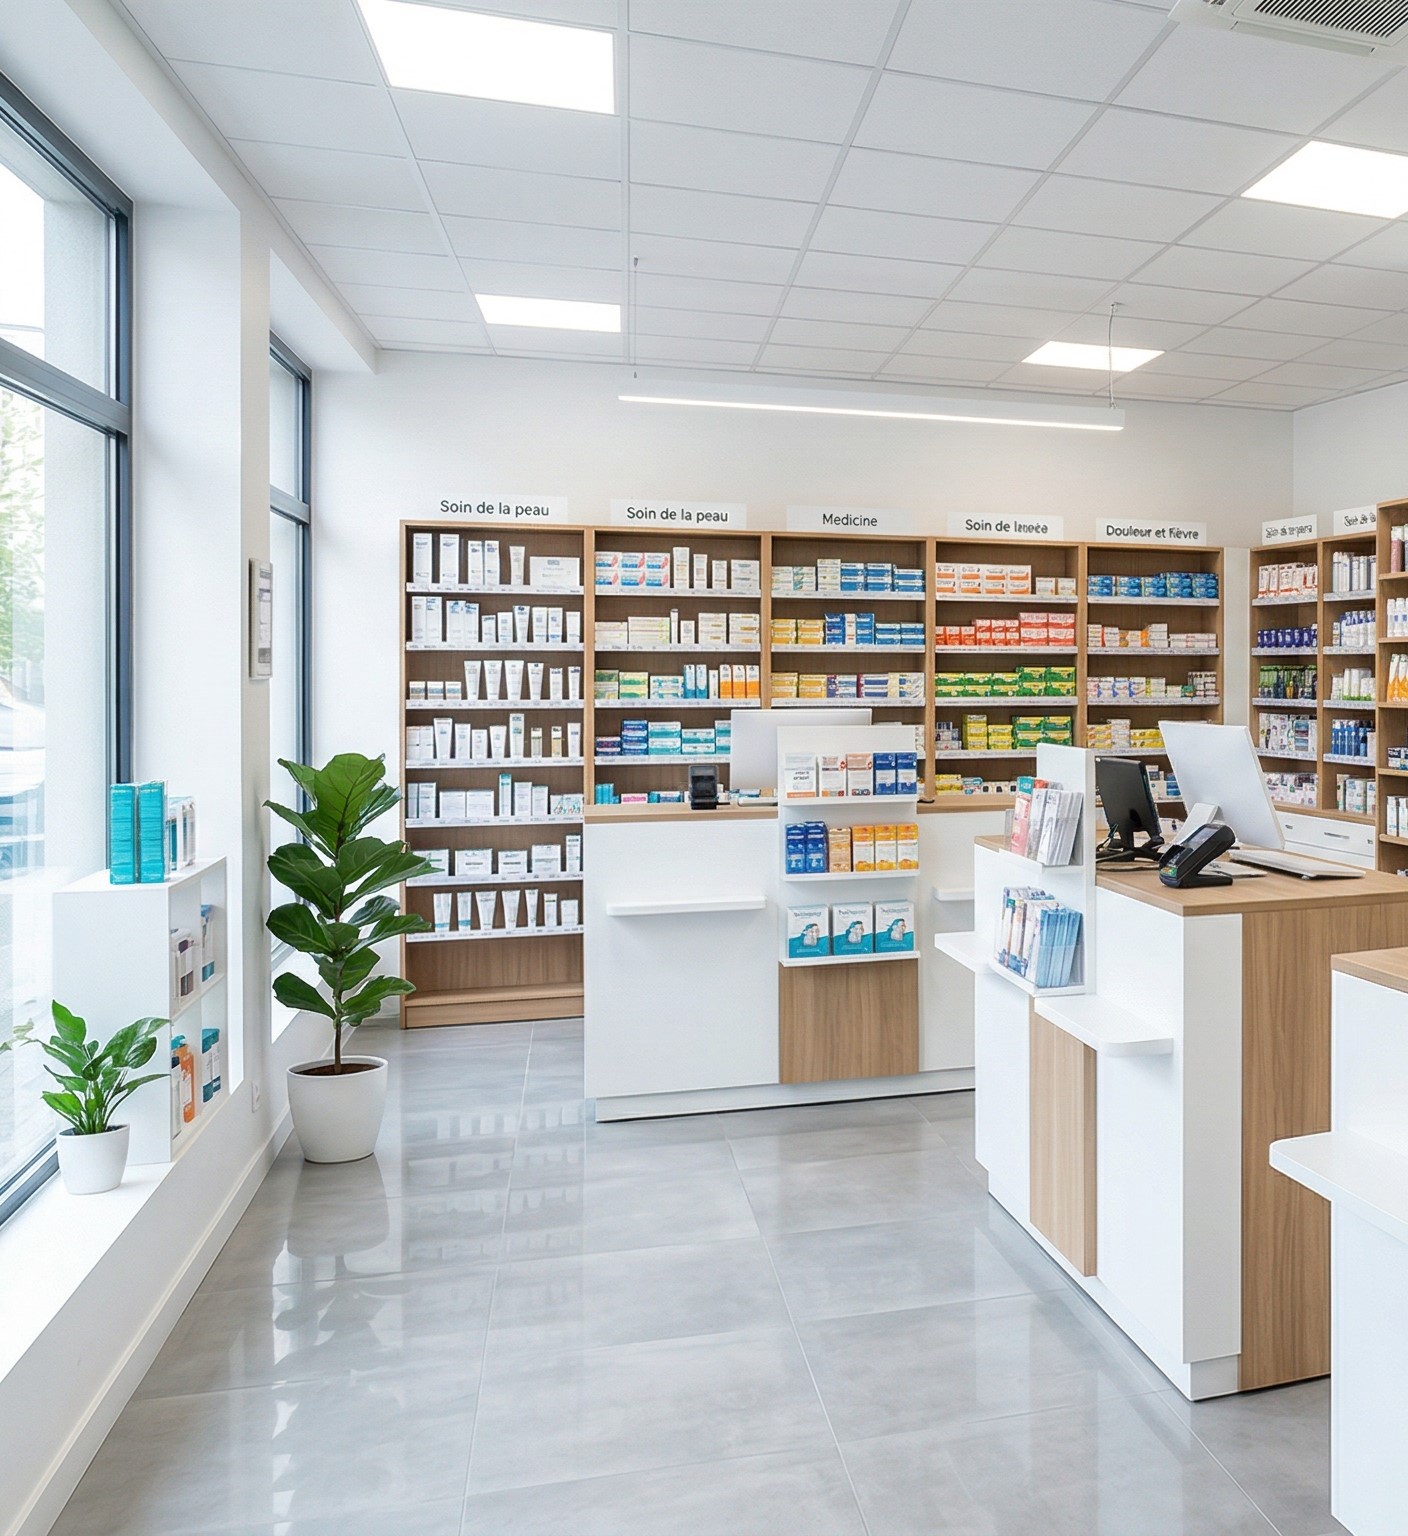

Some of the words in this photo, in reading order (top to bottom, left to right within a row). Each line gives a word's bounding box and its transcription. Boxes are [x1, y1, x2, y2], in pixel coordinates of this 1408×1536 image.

[440, 499, 472, 514] Soin
[476, 501, 495, 515] de
[498, 502, 511, 516] la
[515, 504, 549, 517] peau
[626, 506, 657, 520] Soin
[660, 507, 677, 521] de
[681, 508, 692, 522] la
[696, 511, 728, 523] peau
[822, 513, 878, 527] Medicine
[965, 518, 992, 532] Soin
[995, 520, 1011, 533] de
[1154, 527, 1167, 539] et
